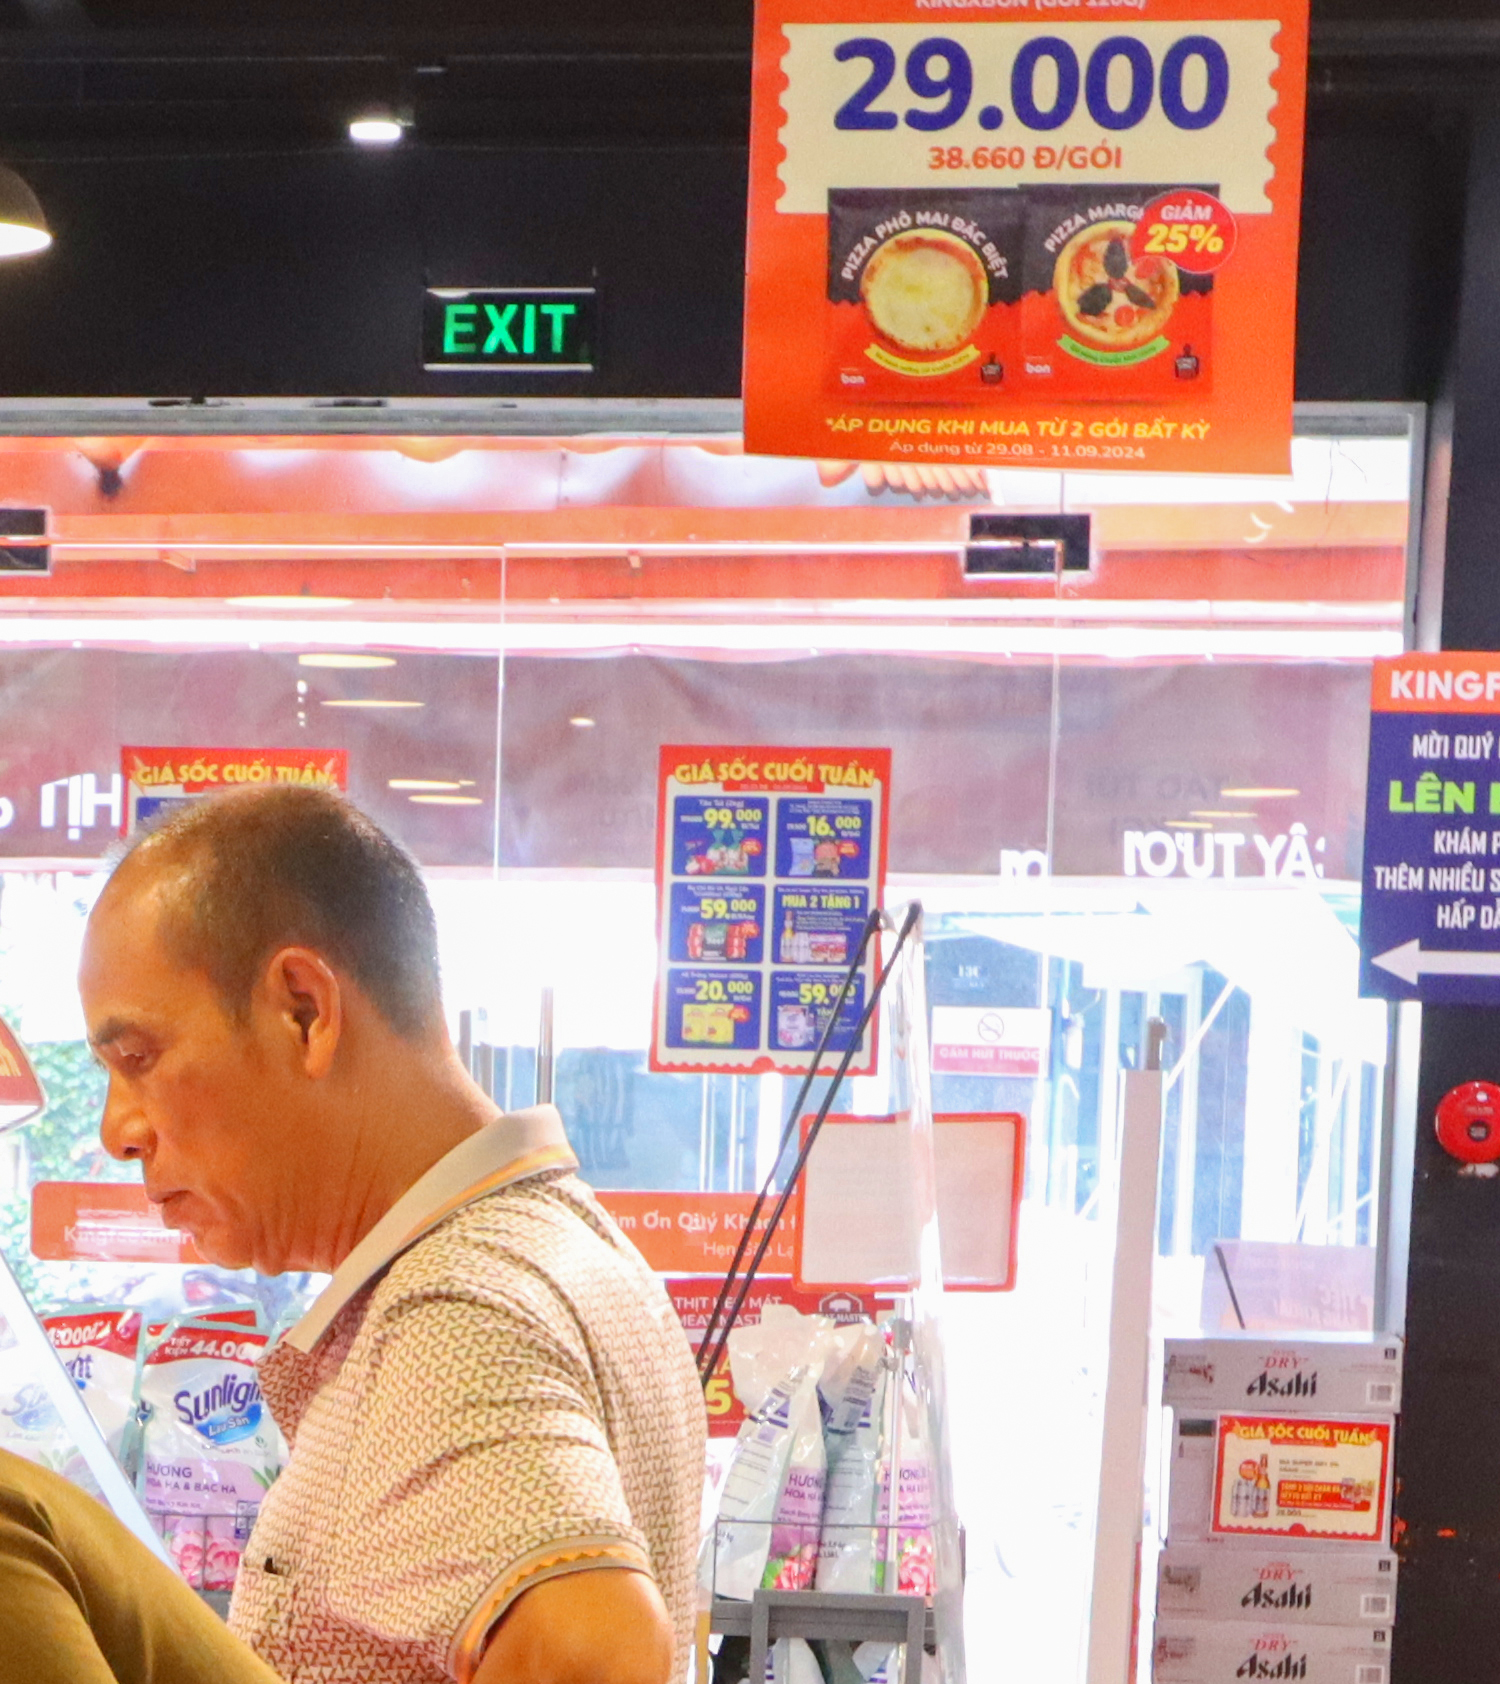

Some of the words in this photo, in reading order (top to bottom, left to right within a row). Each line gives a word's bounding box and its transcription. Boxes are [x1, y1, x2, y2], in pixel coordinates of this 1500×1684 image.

[833, 35, 1230, 131] 29.000
[928, 146, 1025, 171] 38.660
[1033, 139, 1122, 171] Đ/GÓI
[1160, 201, 1213, 220] GIẢM
[840, 236, 877, 281] PIZZA
[875, 210, 911, 239] PHÔ
[915, 210, 950, 227] MAI
[950, 216, 985, 248] ĐẶC
[982, 242, 1010, 281] BIỆT
[1043, 213, 1087, 253] PIZZA
[1144, 223, 1224, 254] 25%
[443, 303, 576, 354] EXIT
[868, 418, 932, 436] DỤNG
[937, 418, 975, 434] KHI
[979, 419, 1029, 436] MUA
[1036, 414, 1067, 437] TỪ
[1072, 421, 1083, 437] 2
[1088, 415, 1129, 438] GÓI
[1133, 413, 1177, 439] BẤT
[1182, 416, 1211, 439] KỲ
[986, 443, 1034, 456] 29.08
[1050, 445, 1145, 460] 11.09.2024
[1412, 729, 1450, 759] MỜI
[1454, 730, 1495, 760] QUÝ
[136, 760, 175, 786] GIÁ
[178, 758, 219, 784] SỐC
[222, 757, 272, 784] CUỐI
[674, 757, 715, 784] GIÁ
[717, 754, 759, 781] SỐC
[762, 756, 815, 783] CUỐI
[818, 759, 875, 788] TUẦN
[1388, 771, 1476, 814] LÊN
[1433, 826, 1487, 855] KHÁM
[1373, 861, 1424, 892] THÊM
[1428, 860, 1485, 893] NHIỀU
[781, 894, 808, 909] MUA
[809, 895, 818, 909] 2
[1436, 896, 1476, 930] HẤP
[643, 1208, 673, 1230] Ơn
[674, 1296, 708, 1316] THỊT
[748, 1293, 783, 1310] MÁT
[1246, 1371, 1318, 1398] Asahi
[1266, 1422, 1295, 1439] SỐC
[1240, 1581, 1312, 1610] Asahi
[1235, 1652, 1307, 1680] Asahi
